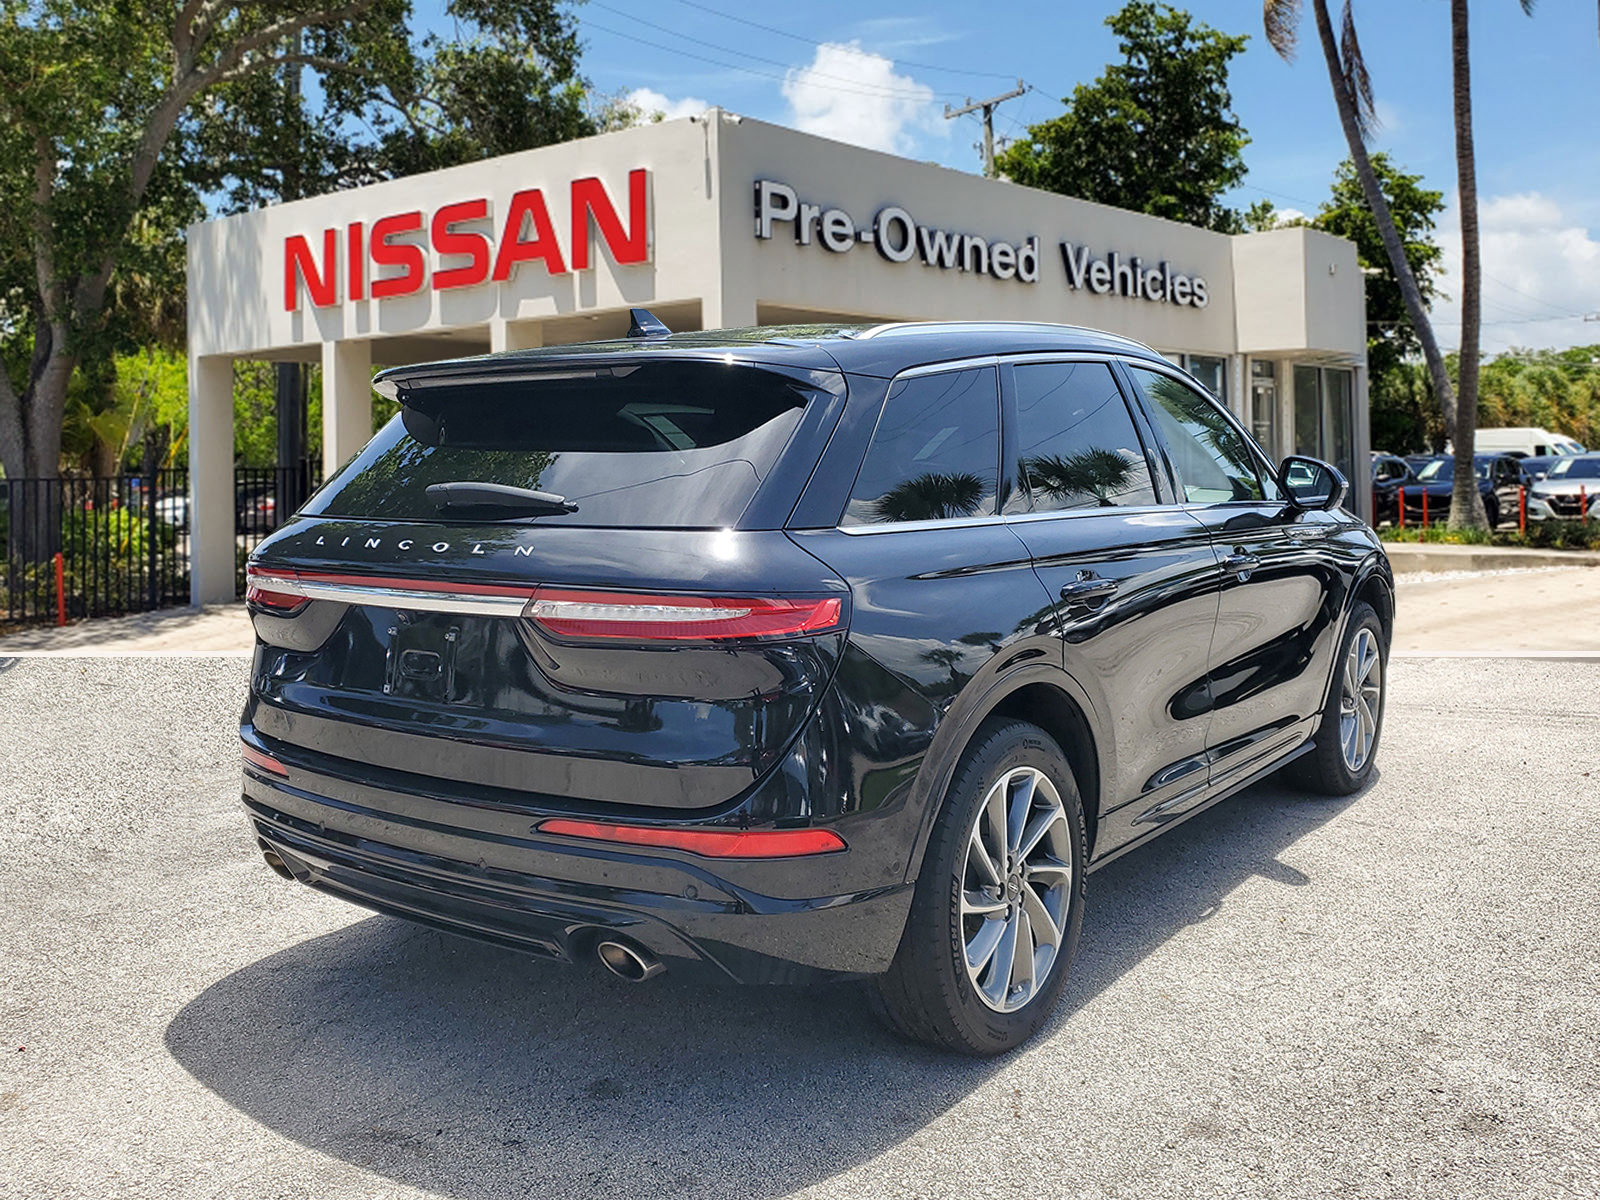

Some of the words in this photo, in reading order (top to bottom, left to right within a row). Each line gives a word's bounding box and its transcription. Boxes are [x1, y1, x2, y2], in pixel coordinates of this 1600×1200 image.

[285, 168, 647, 312] NISSAN
[754, 180, 1040, 283] Pre-Owned
[1061, 241, 1209, 309] Vehicles
[316, 535, 535, 557] LINCOLN
